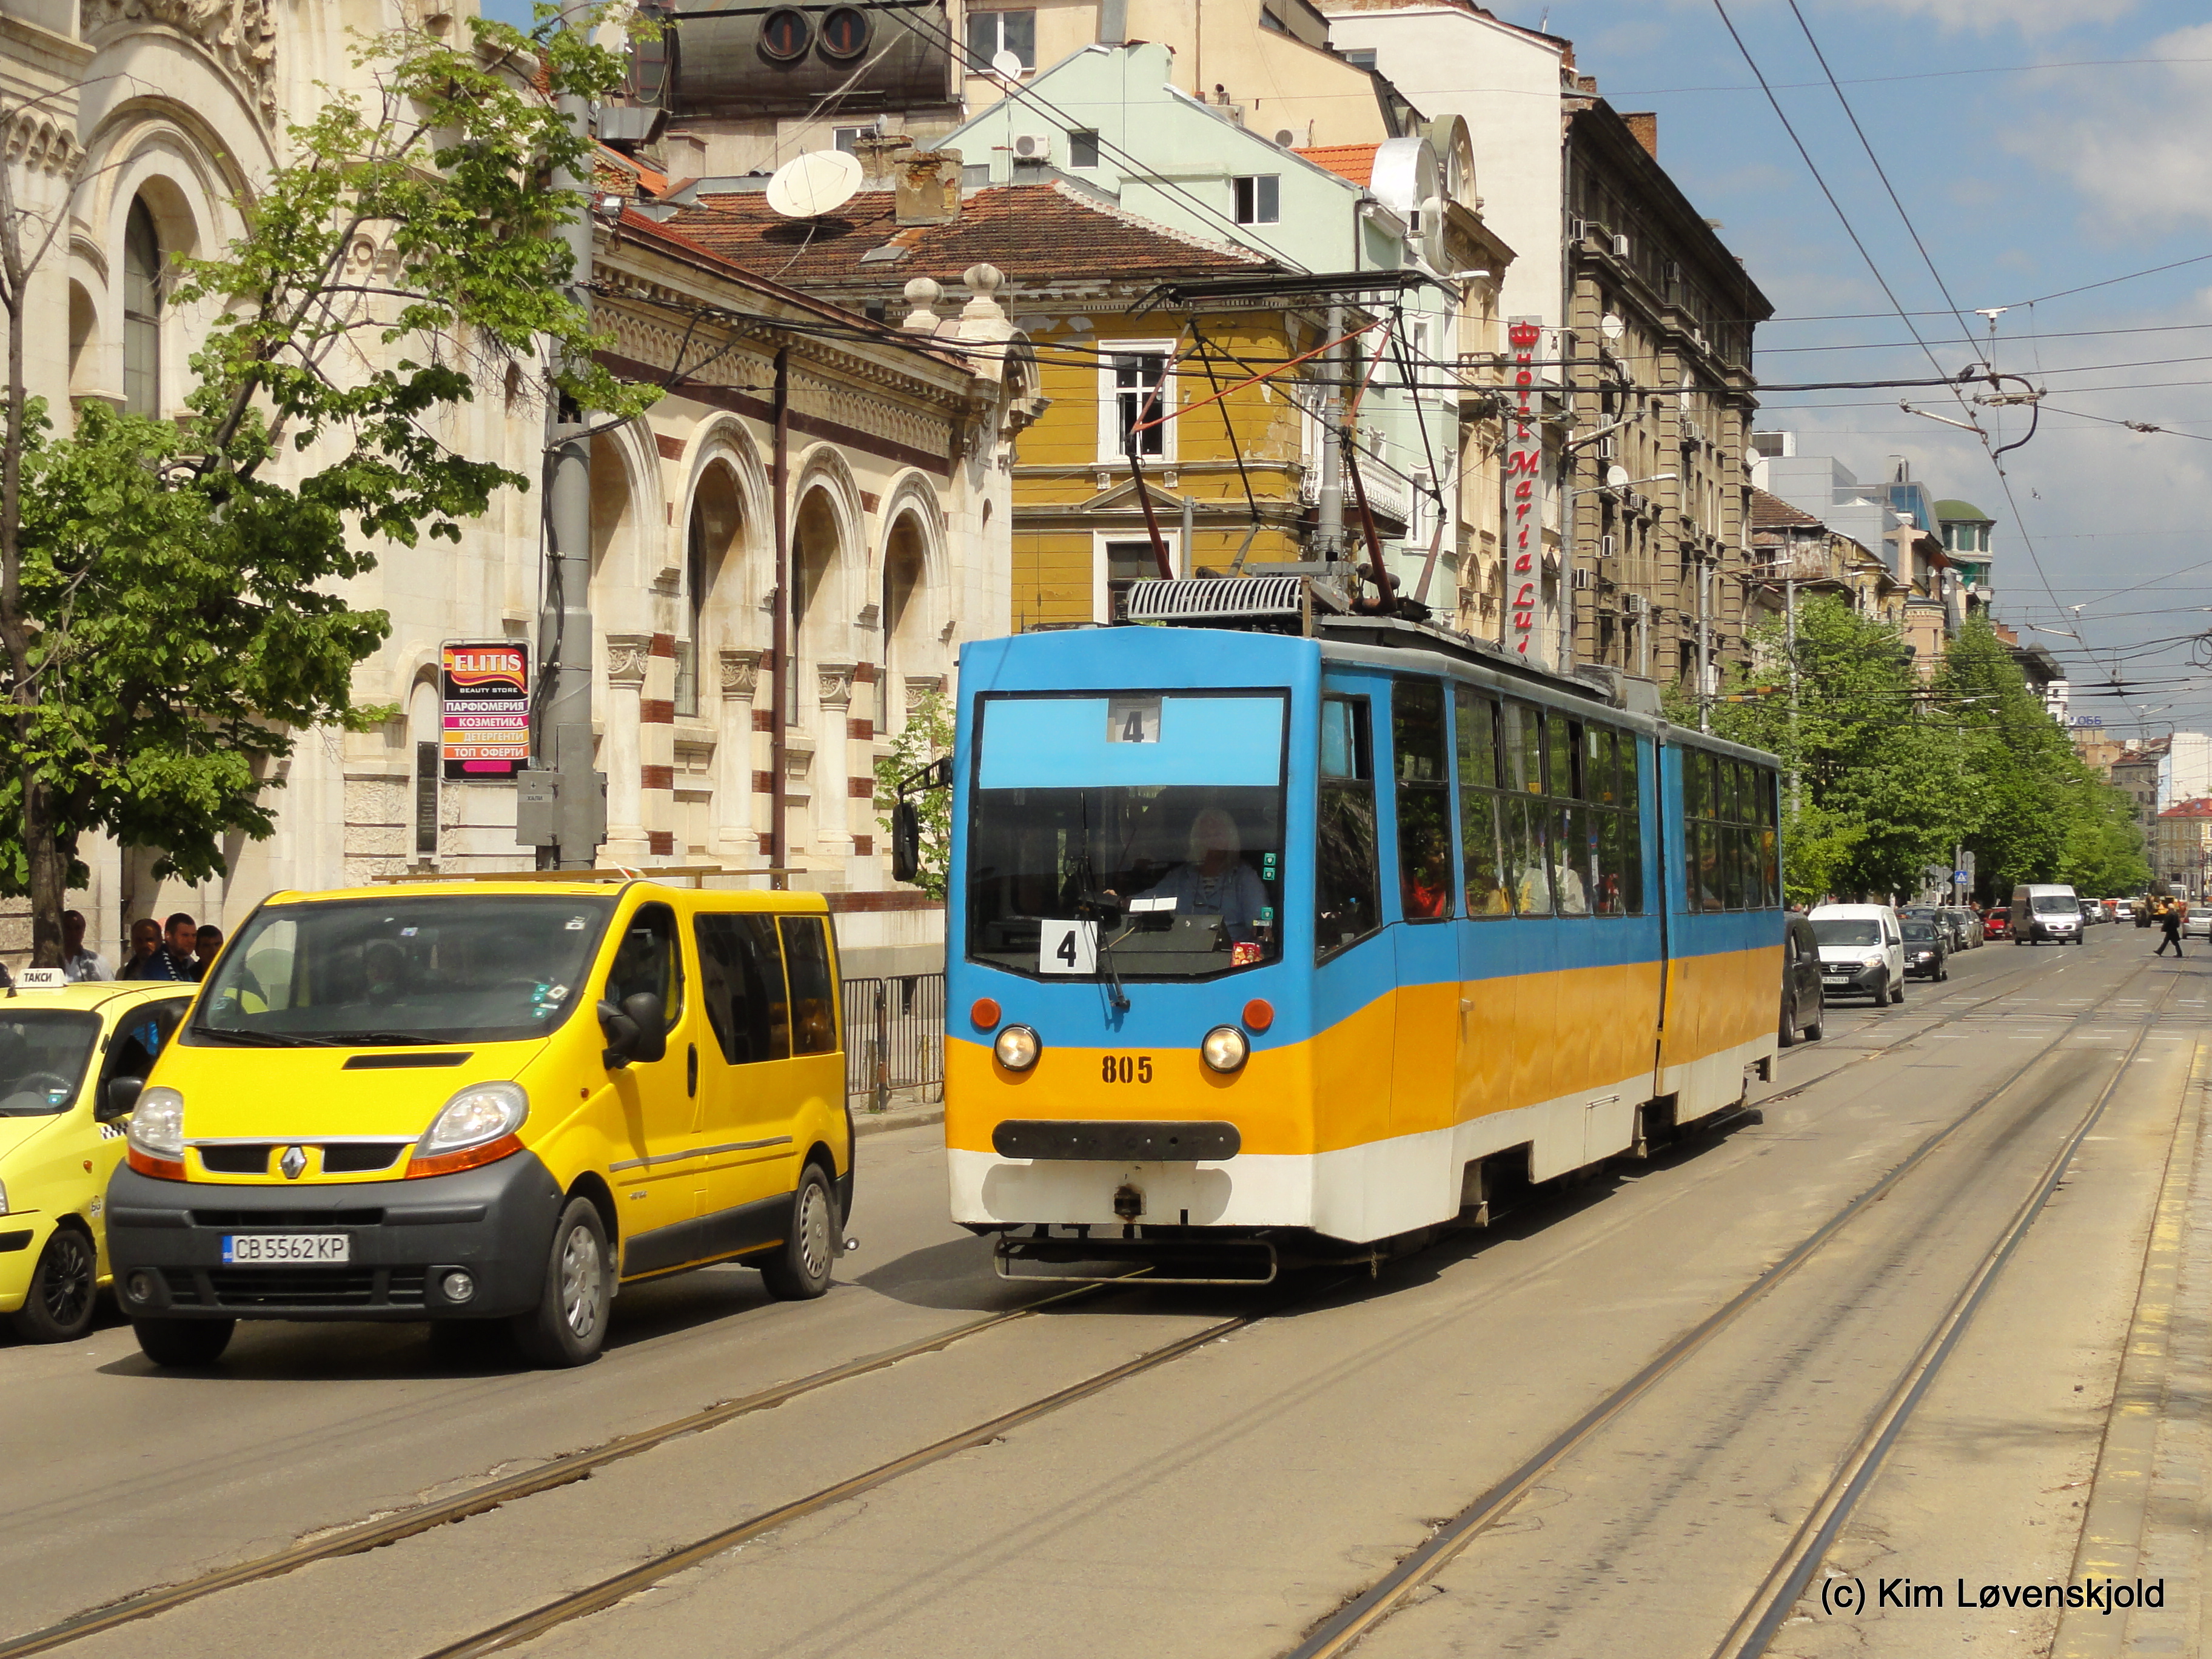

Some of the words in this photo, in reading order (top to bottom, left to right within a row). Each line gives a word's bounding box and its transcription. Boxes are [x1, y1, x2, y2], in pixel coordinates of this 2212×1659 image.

[1507, 449, 1541, 571] Maria
[455, 654, 521, 672] ELITIS
[446, 702, 524, 712] ПАРФЮМЕРИЯ
[459, 717, 524, 727] КОЗМЕТИКА
[1122, 711, 1145, 743] 4
[2077, 716, 2102, 725] ОББ
[463, 732, 524, 742] ДЕТЕРГЕНТИ
[454, 748, 476, 757] ТОП
[480, 748, 524, 757] ОФЕРТИ
[1057, 931, 1076, 967] 4
[24, 973, 52, 982] ТАКСИ
[1102, 1055, 1153, 1084] 805
[236, 1238, 261, 1259] CB
[265, 1238, 313, 1259] 5562
[318, 1238, 344, 1259] KP
